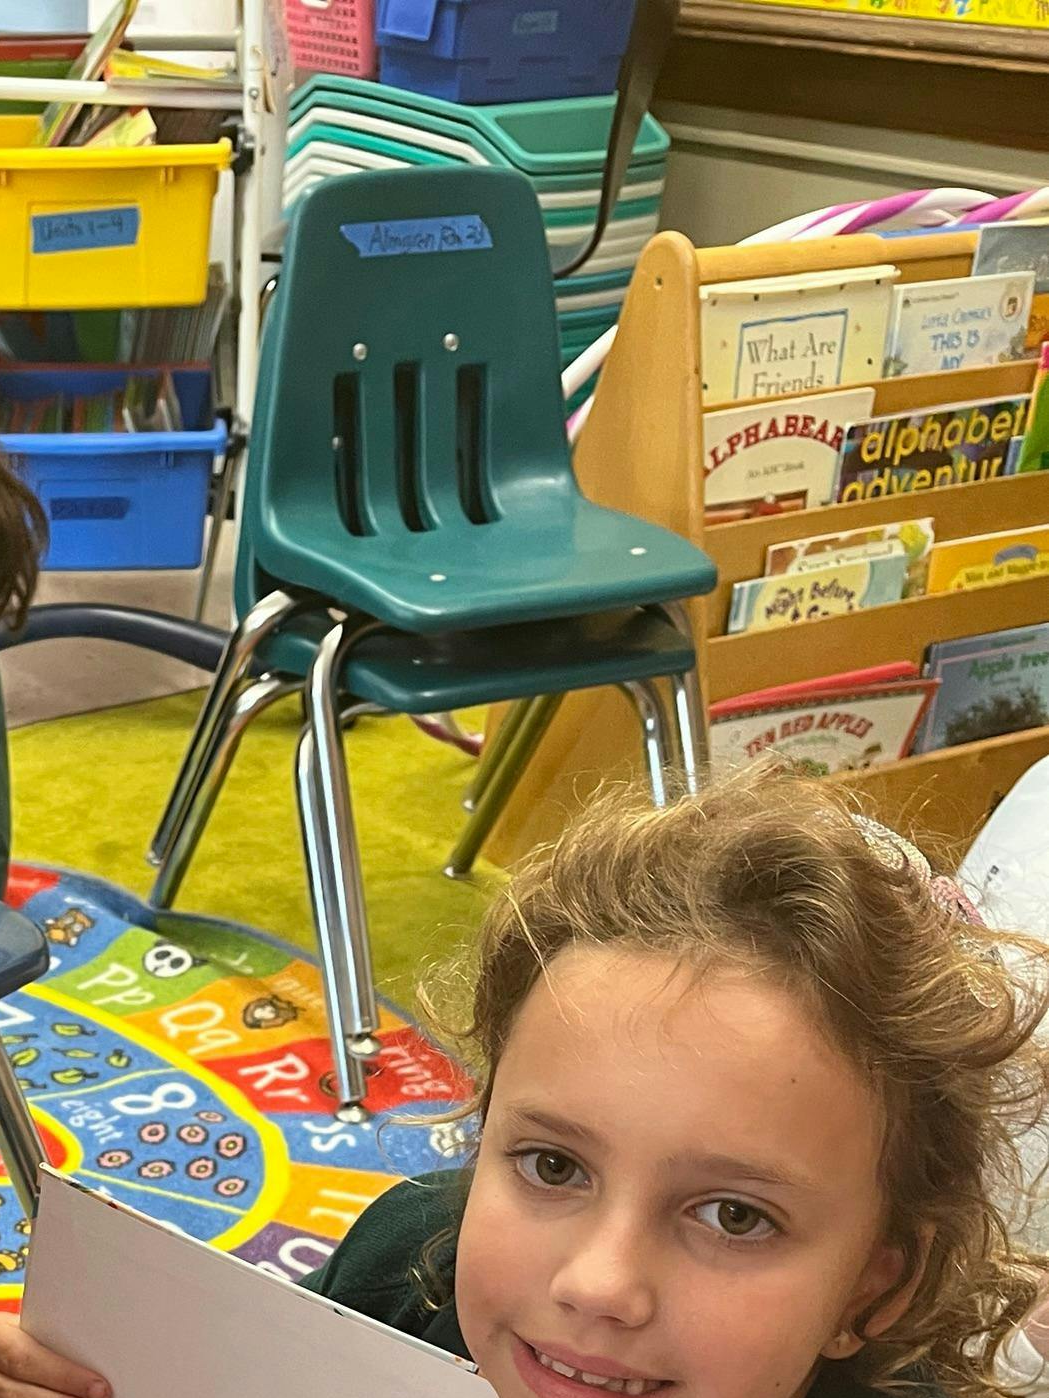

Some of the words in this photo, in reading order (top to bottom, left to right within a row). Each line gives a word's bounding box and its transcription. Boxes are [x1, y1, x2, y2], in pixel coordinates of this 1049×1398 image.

[747, 334, 795, 365] What
[800, 333, 837, 358] Are
[752, 362, 824, 397] Friends
[860, 400, 1026, 466] alphabet
[780, 714, 815, 740] RED
[817, 711, 874, 740] APPLES
[76, 962, 156, 1006] Pp
[159, 1001, 242, 1056] Qq
[109, 1082, 197, 1115] 8
[237, 1053, 311, 1104] Rr
[61, 1099, 125, 1145] eight
